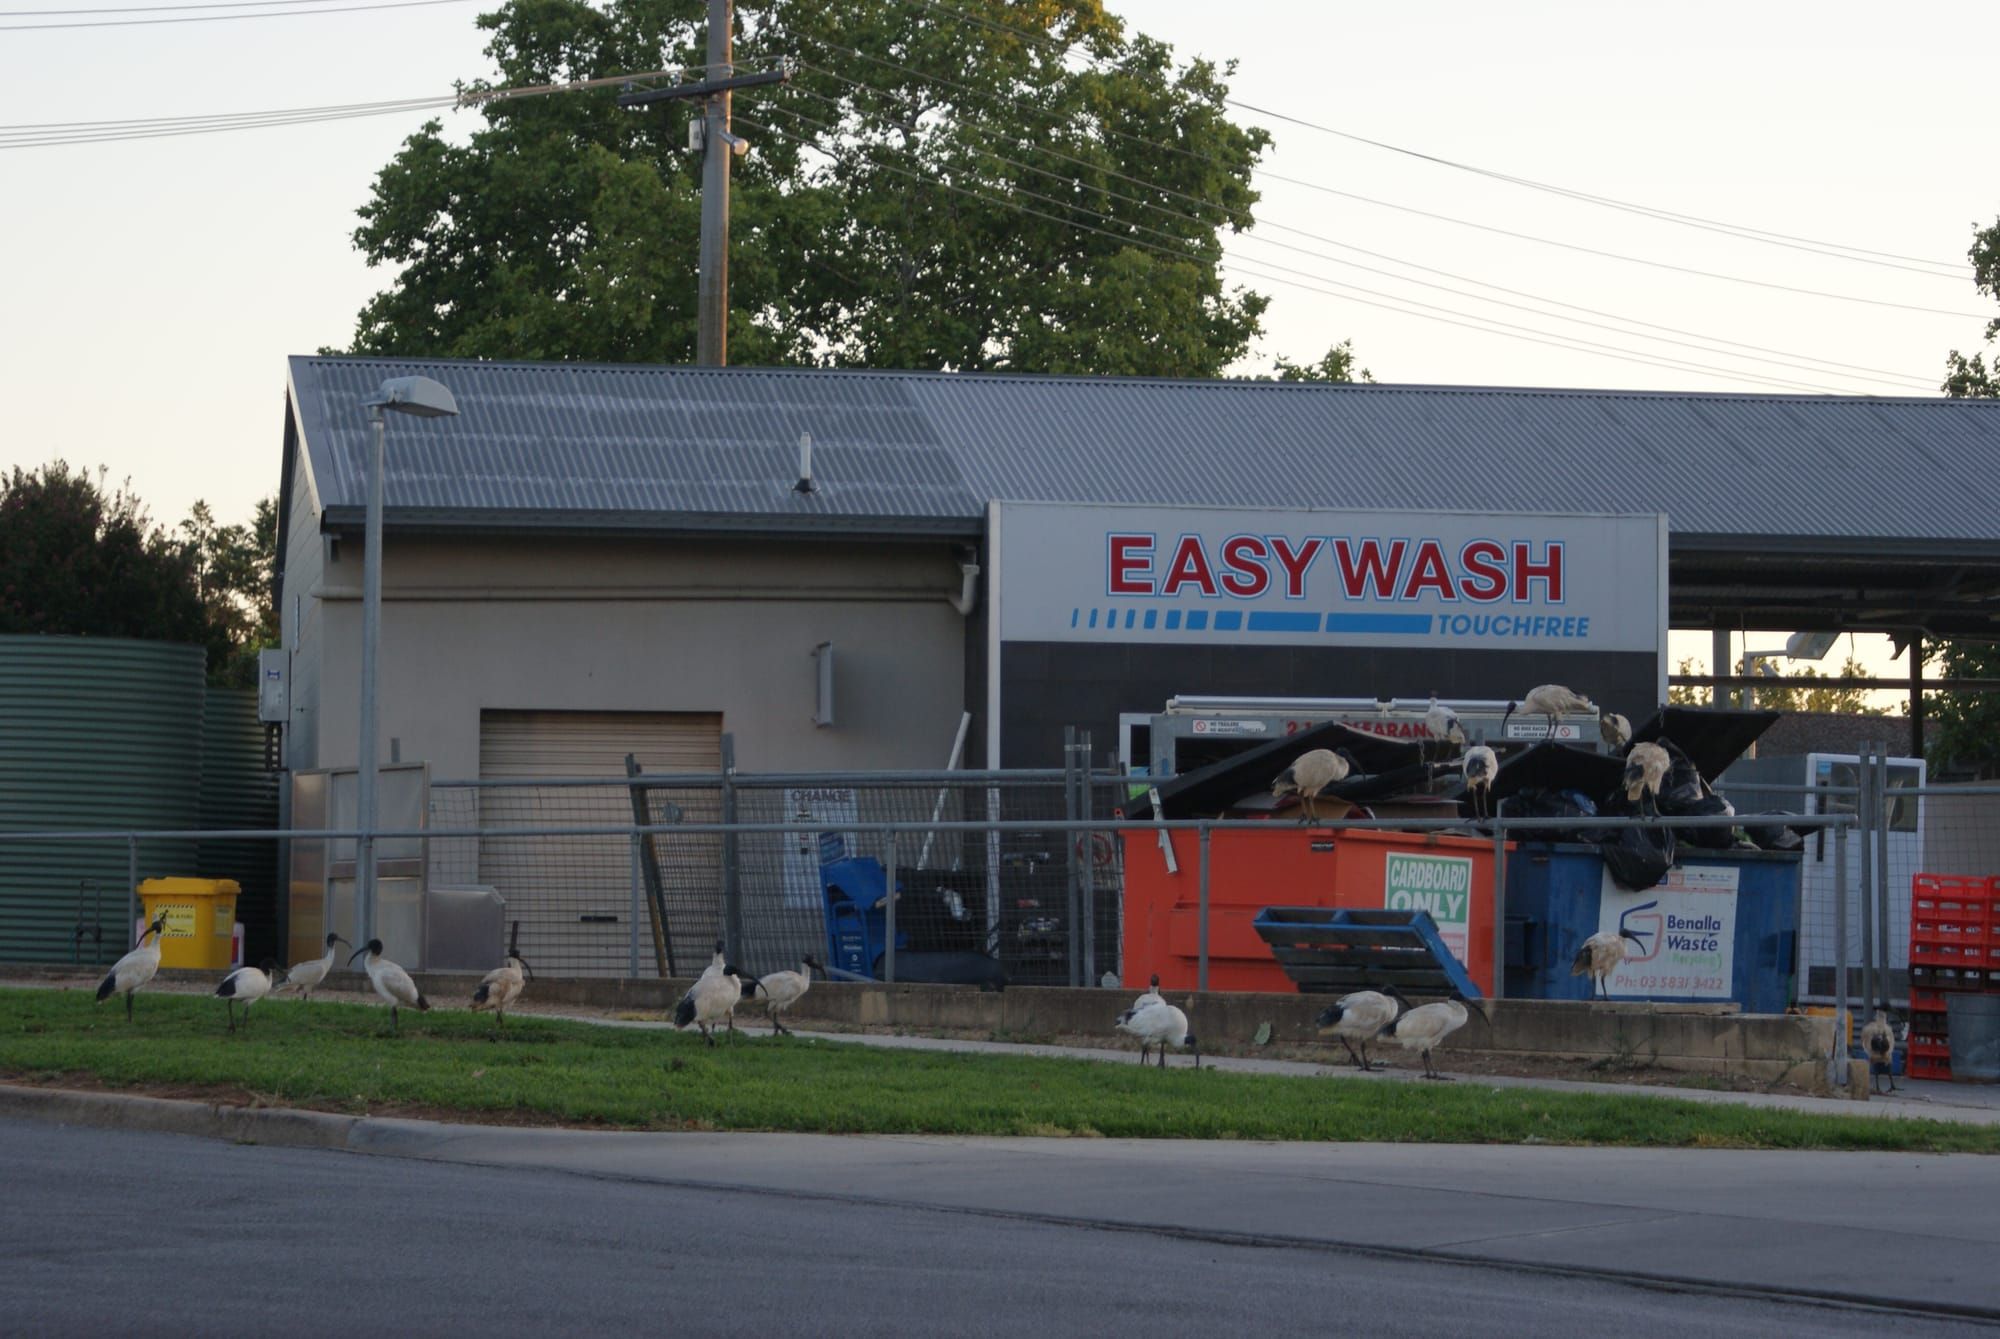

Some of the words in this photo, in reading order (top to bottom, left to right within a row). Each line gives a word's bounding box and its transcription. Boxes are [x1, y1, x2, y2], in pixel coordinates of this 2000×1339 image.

[1438, 614, 1589, 637] TOUCHFREE
[1390, 859, 1467, 891] CARDBOARD
[1390, 889, 1464, 920] ONLY
[1667, 914, 1721, 930] Benalla
[1667, 935, 1718, 951] Waste
[1615, 975, 1638, 988] Ph:
[1639, 975, 1657, 988] 03
